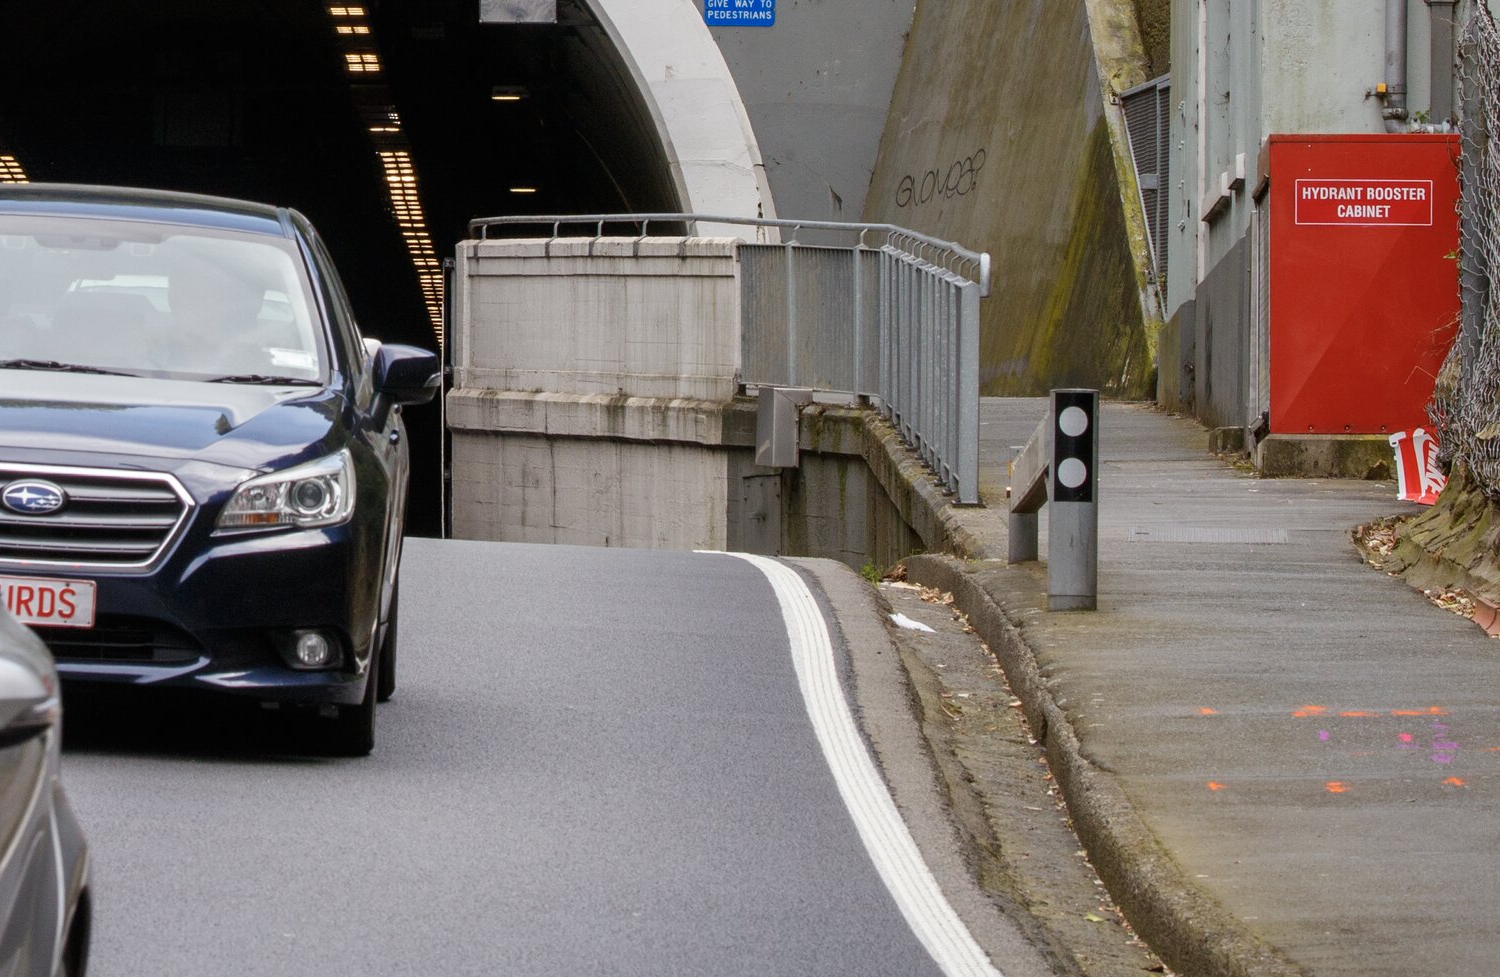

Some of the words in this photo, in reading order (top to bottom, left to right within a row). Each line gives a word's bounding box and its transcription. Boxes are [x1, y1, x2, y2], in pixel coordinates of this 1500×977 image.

[707, 0, 729, 8] GIVE
[735, 0, 755, 8] WAY
[760, 0, 772, 8] TO
[707, 10, 772, 20] PEDESTRIANS
[1302, 187, 1363, 200] HYDRANT
[1366, 188, 1426, 201] BOOSTER
[1337, 205, 1391, 218] CABINET
